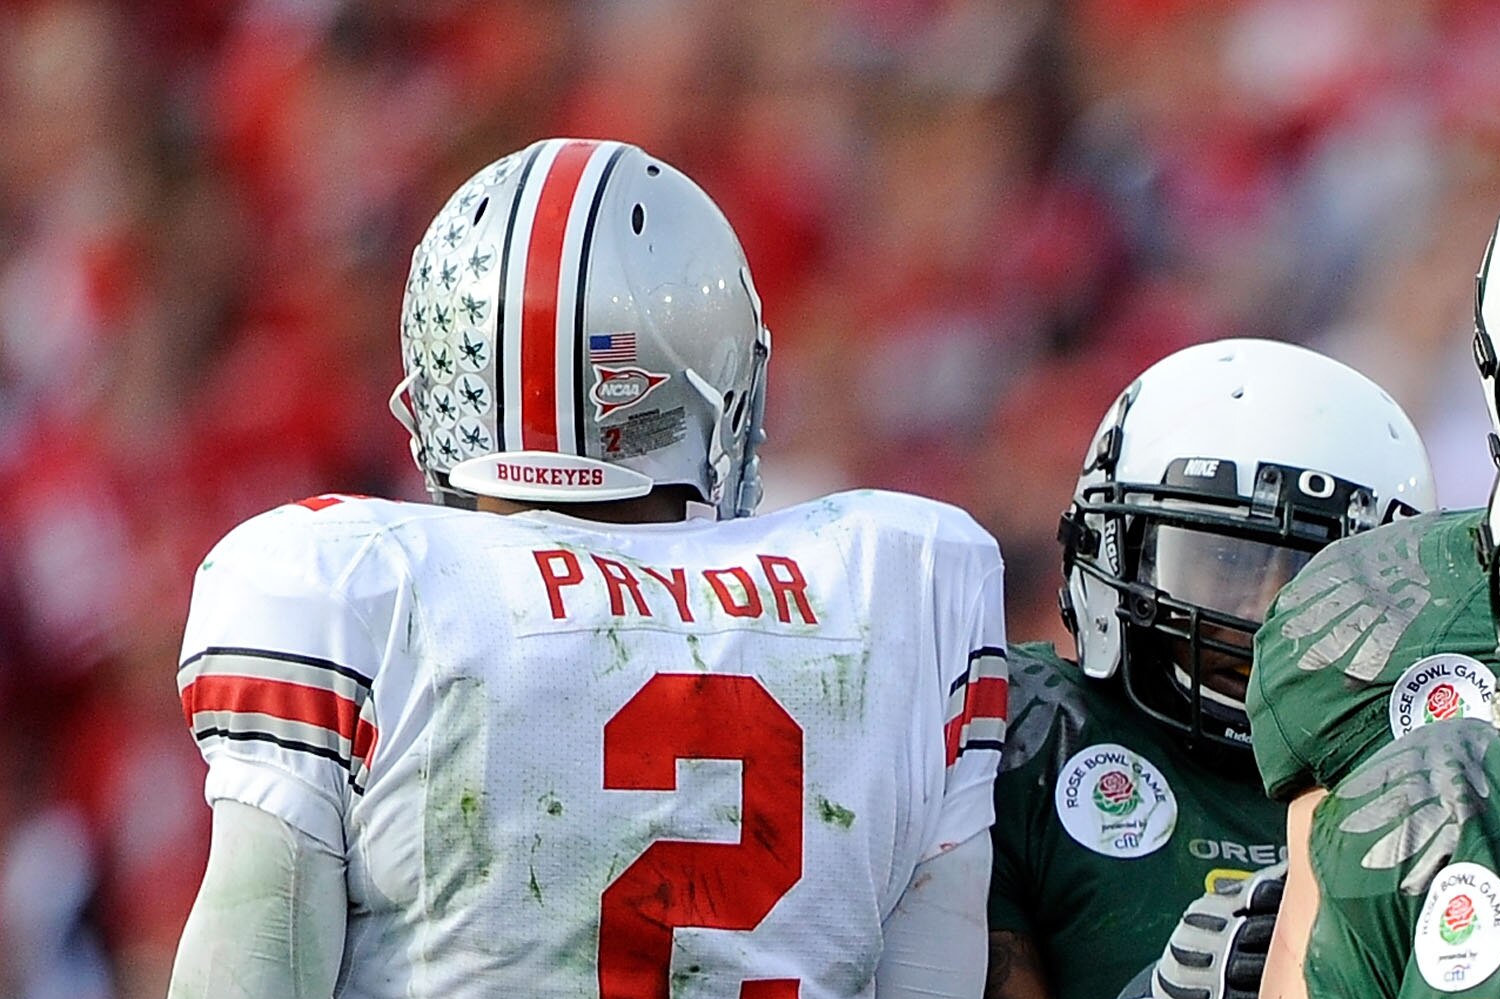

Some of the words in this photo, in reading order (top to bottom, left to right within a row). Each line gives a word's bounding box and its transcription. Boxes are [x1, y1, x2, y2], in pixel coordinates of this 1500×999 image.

[600, 383, 640, 397] NCAA
[605, 427, 621, 453] 2
[497, 463, 603, 486] BUCKEYES
[1183, 459, 1220, 478] NIKE
[1299, 470, 1336, 498] O
[532, 549, 819, 625] PRYOR
[1407, 664, 1451, 693] BOWL
[1455, 665, 1493, 703] GAME
[1066, 766, 1086, 808] ROSE
[1084, 752, 1129, 770] BOWL
[1132, 762, 1167, 803] GAME
[1441, 873, 1477, 892] BOWL
